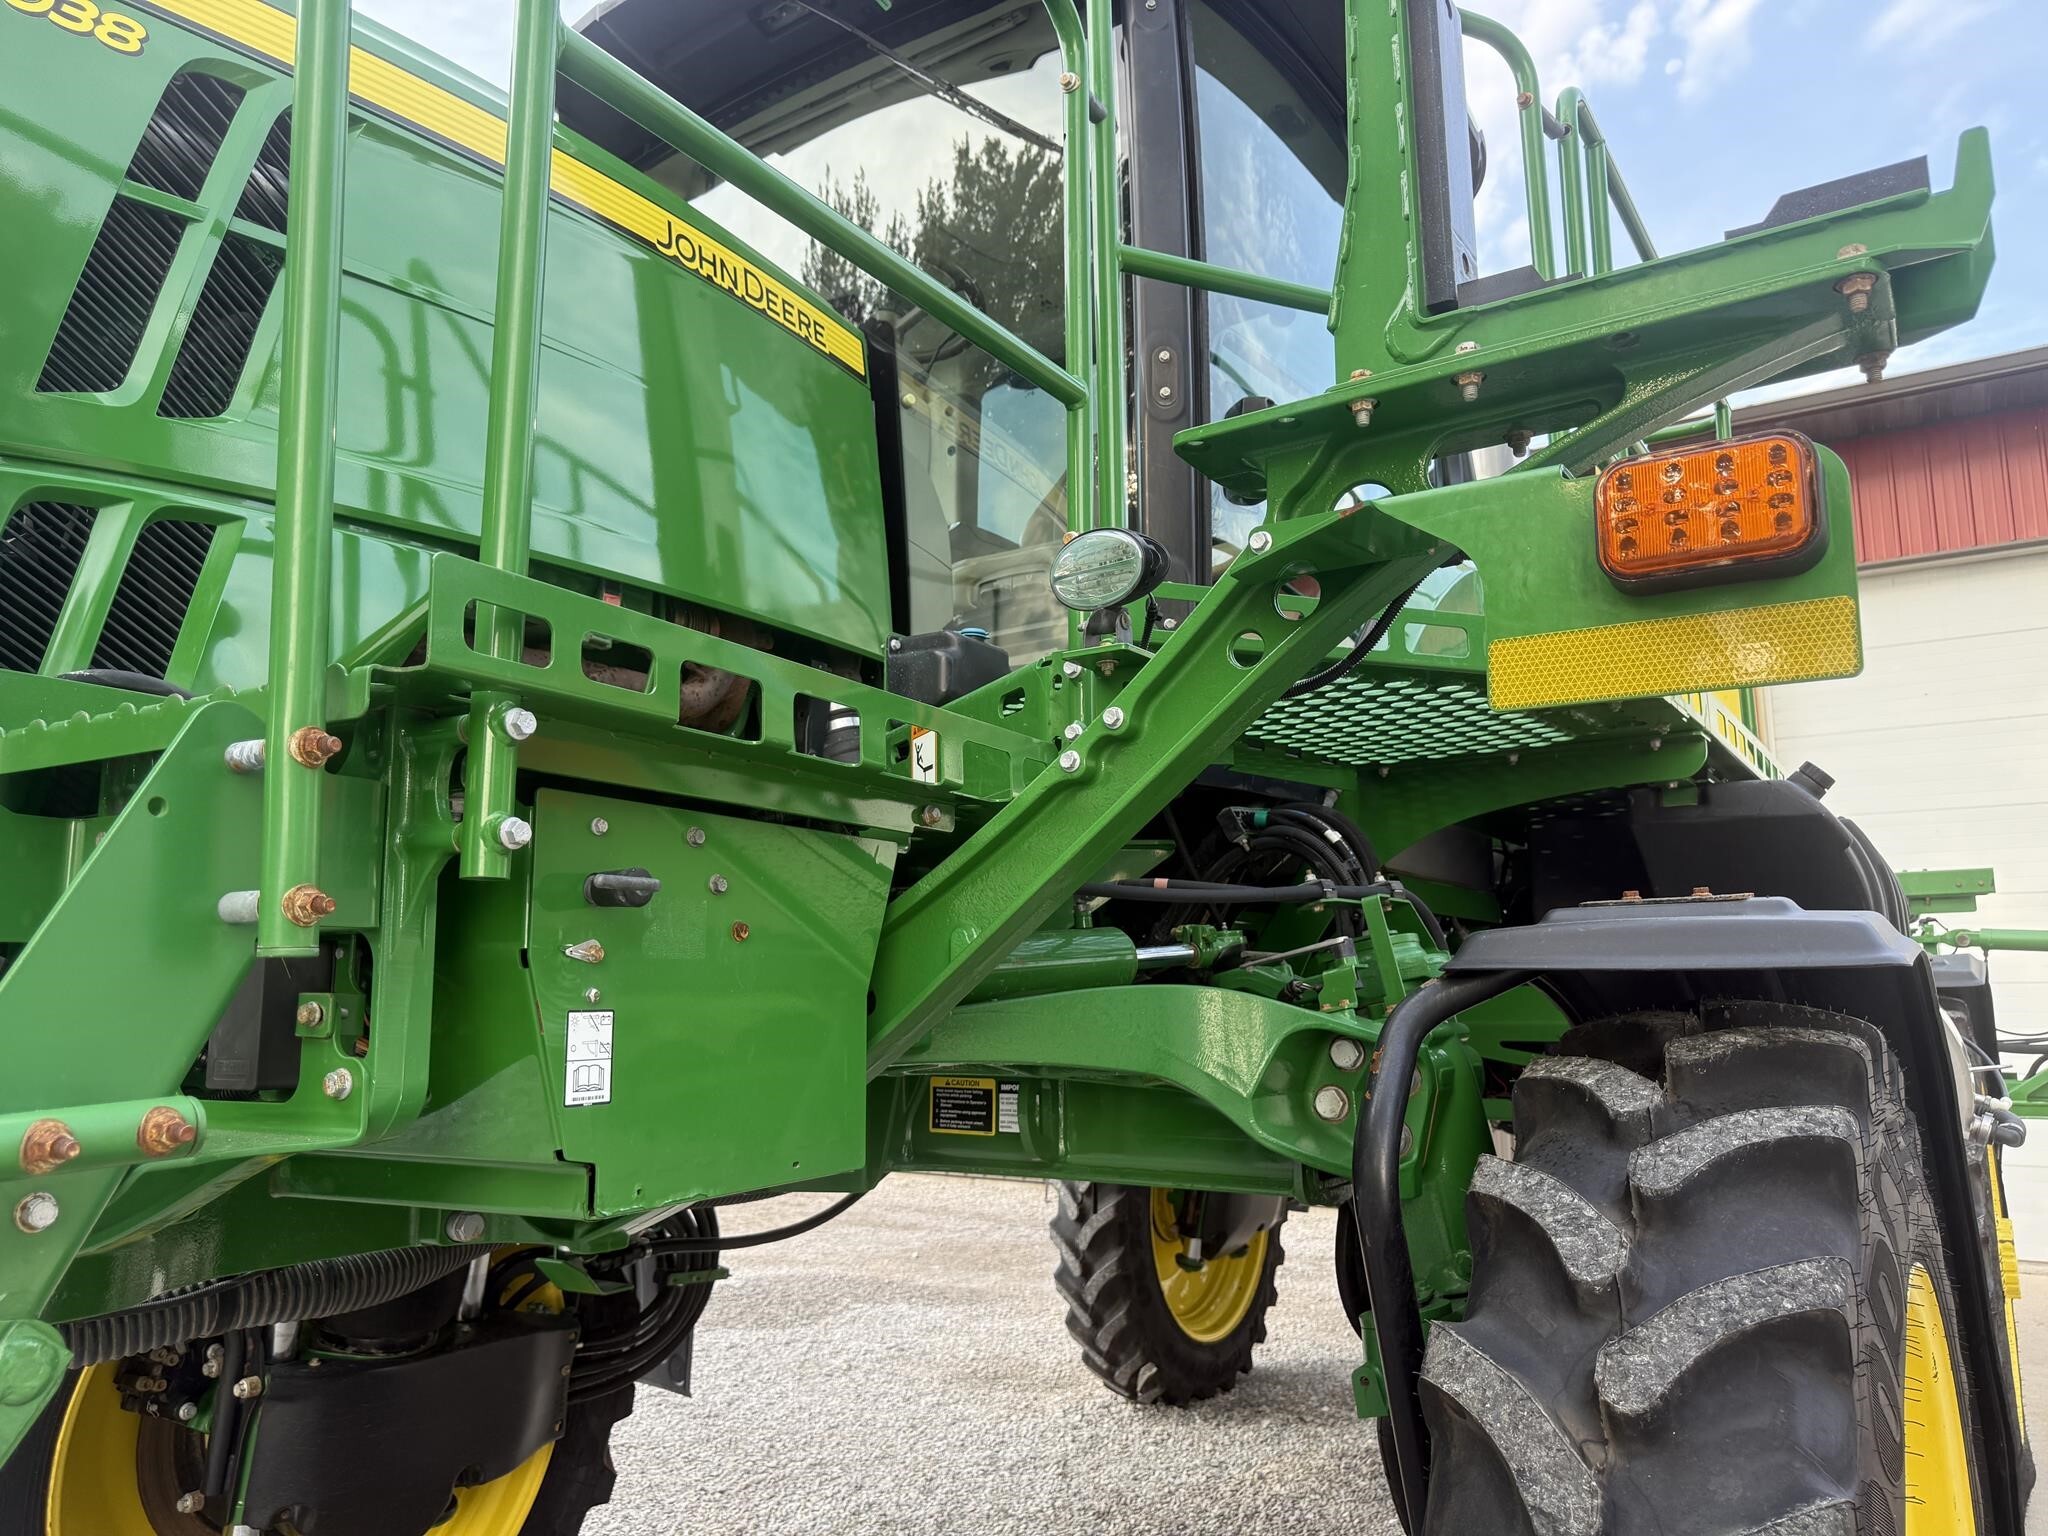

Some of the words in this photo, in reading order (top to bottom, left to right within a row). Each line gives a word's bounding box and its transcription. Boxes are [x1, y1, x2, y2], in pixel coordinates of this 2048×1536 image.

[656, 219, 739, 293] JOHN
[742, 267, 827, 348] DEERE
[951, 1079, 980, 1087] CAUTION
